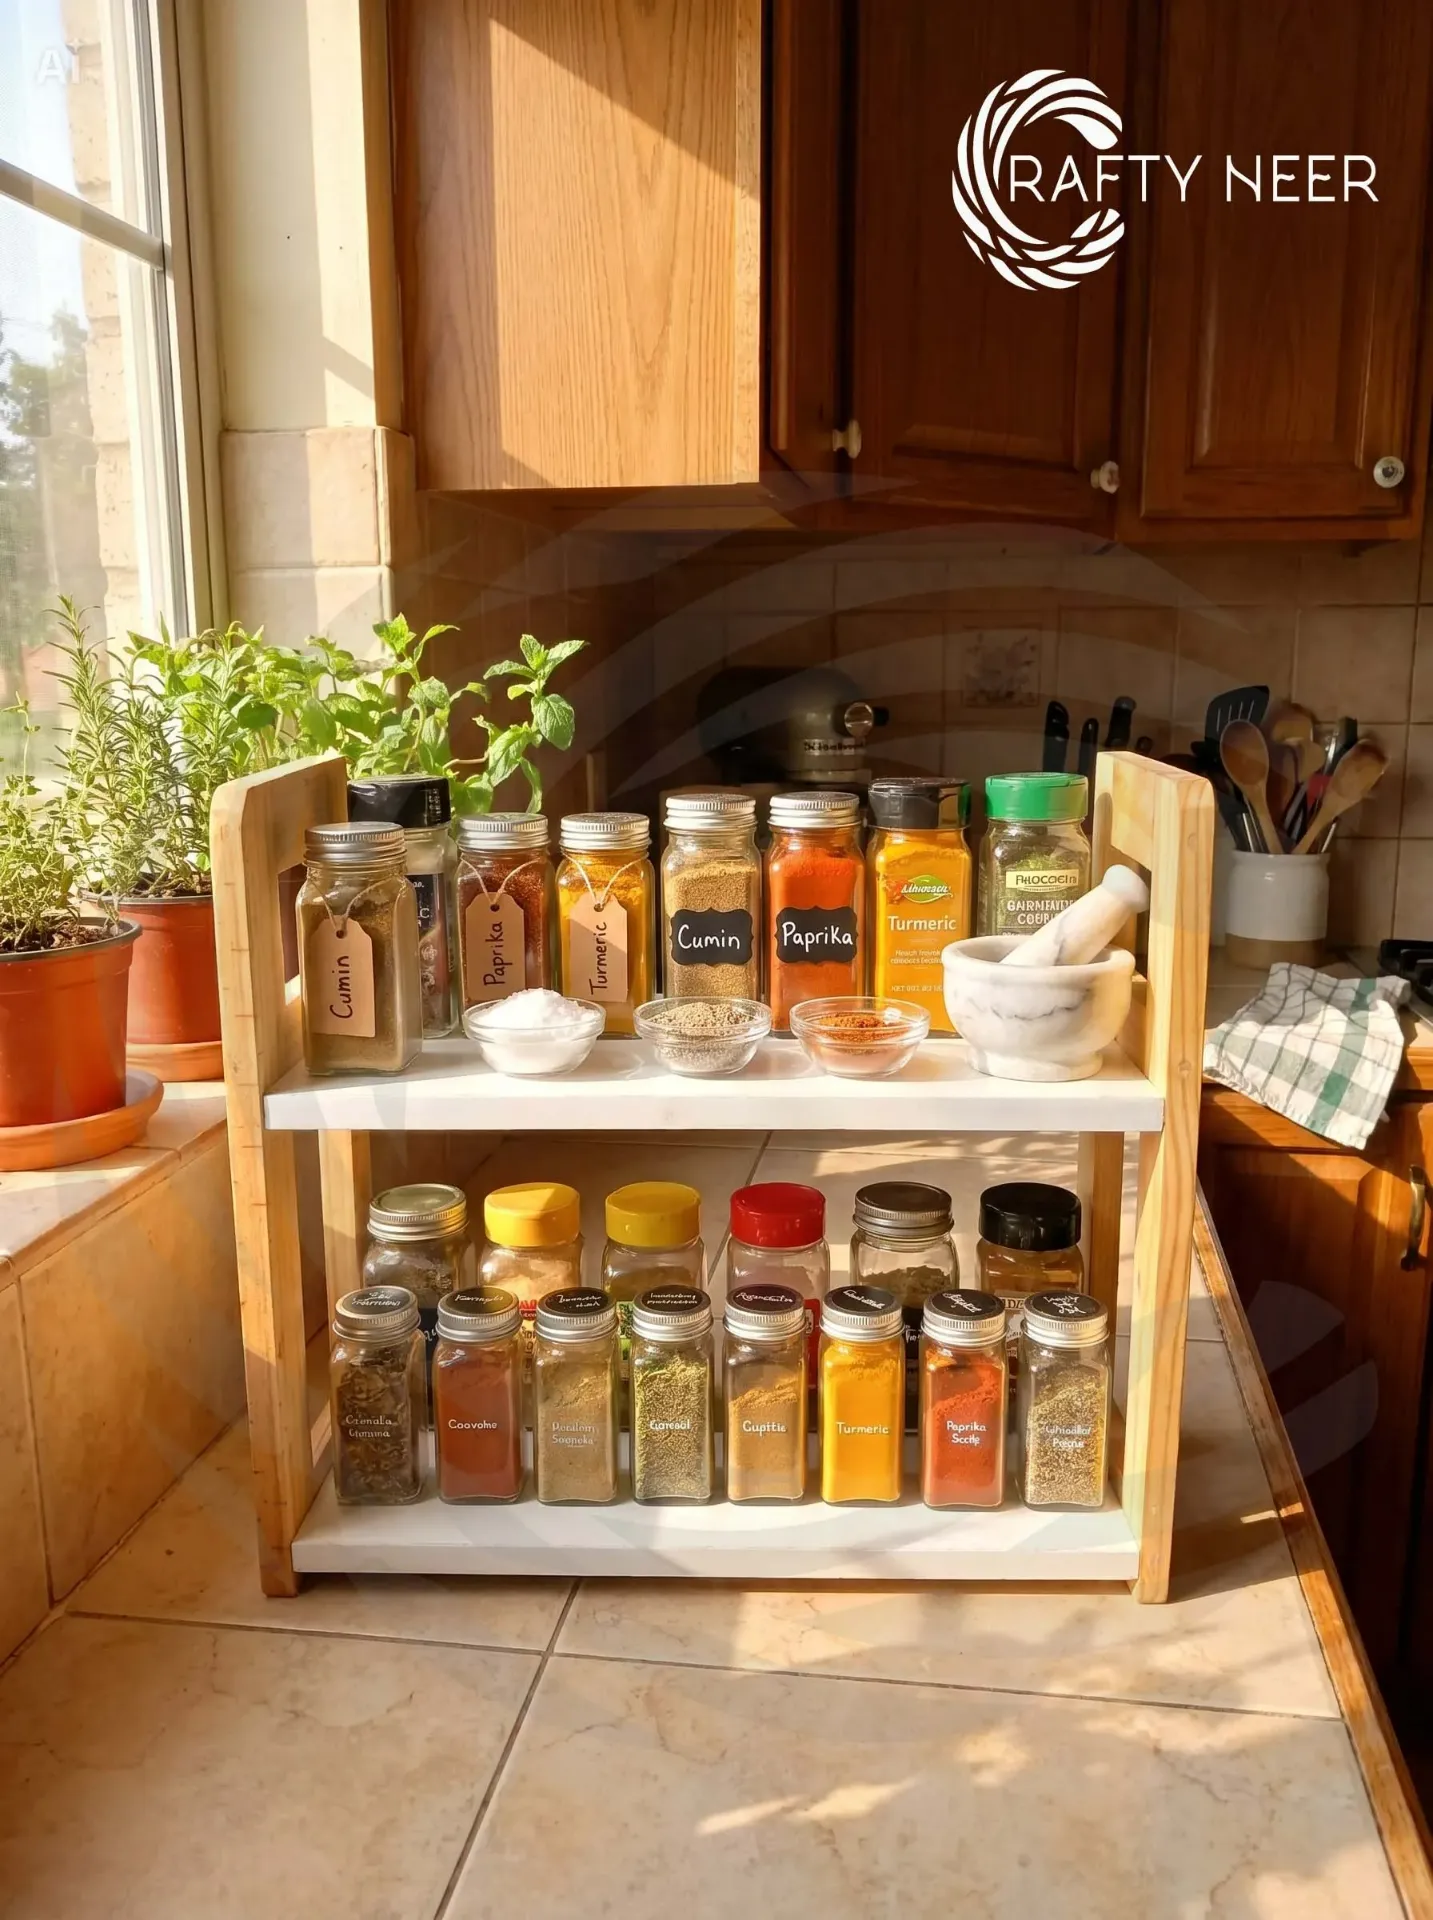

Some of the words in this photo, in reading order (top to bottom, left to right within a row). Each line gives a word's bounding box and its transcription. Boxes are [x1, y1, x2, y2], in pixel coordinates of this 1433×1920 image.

[677, 923, 741, 950] Cumin
[781, 921, 854, 953] Paprika
[888, 915, 957, 931] Turmeric
[483, 921, 513, 987] Paprika
[589, 921, 608, 996] Turmeric
[329, 955, 353, 1019] Cumin
[836, 1421, 889, 1434] Turmeric
[946, 1420, 987, 1433] Paprika
